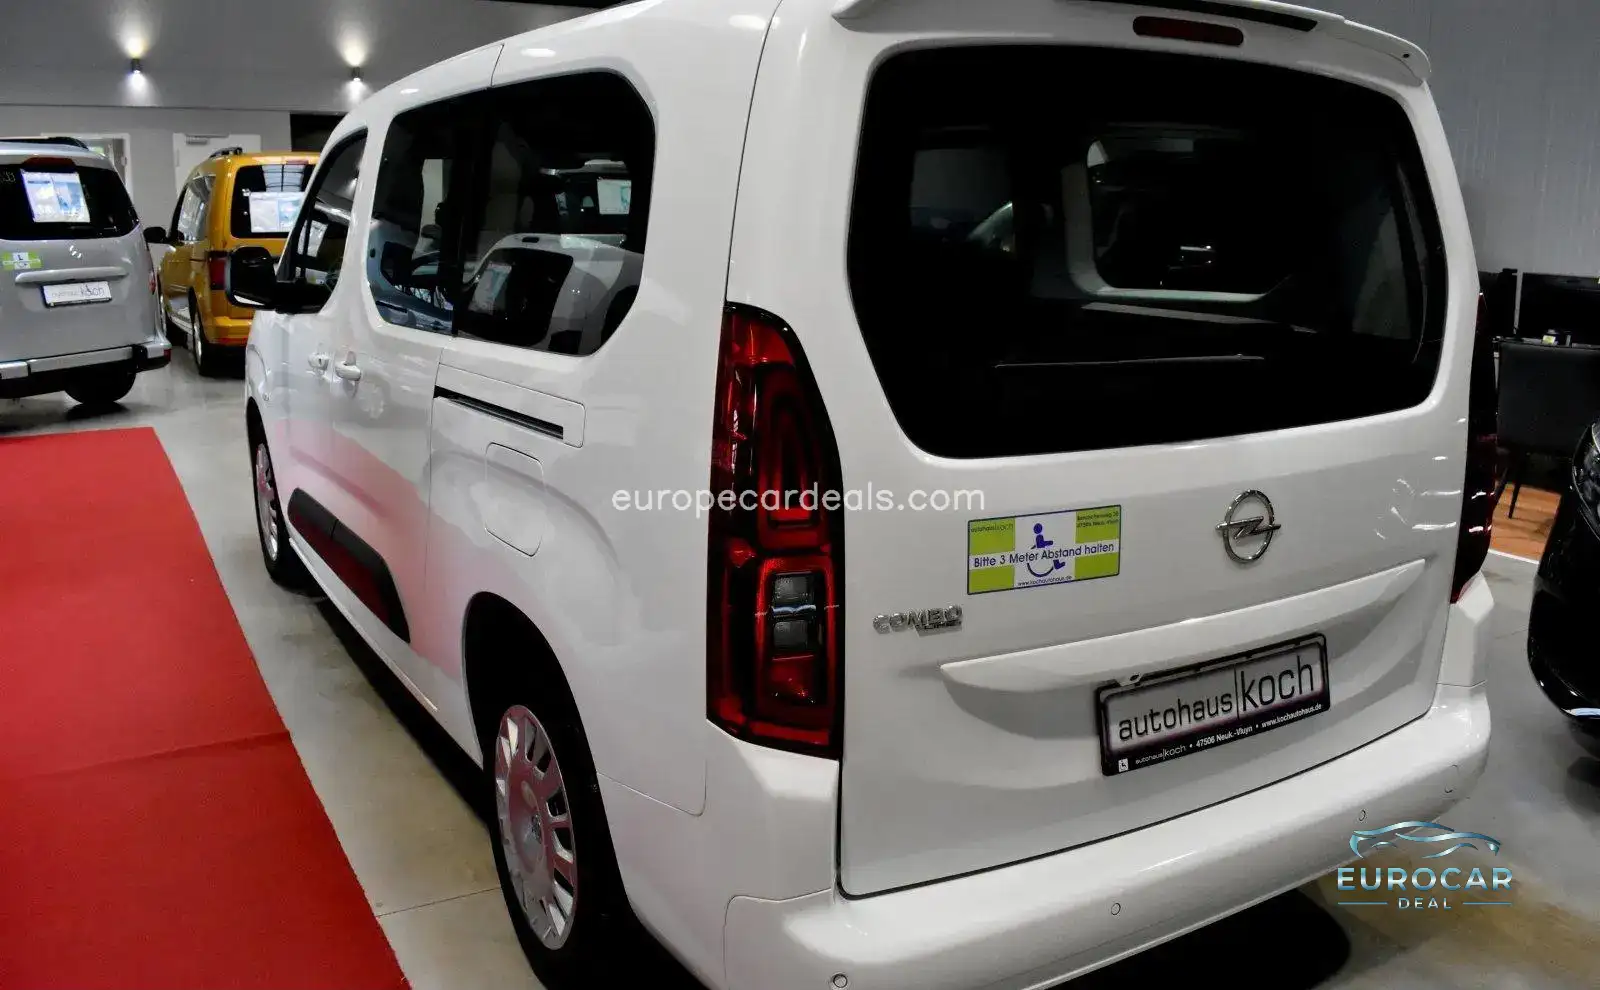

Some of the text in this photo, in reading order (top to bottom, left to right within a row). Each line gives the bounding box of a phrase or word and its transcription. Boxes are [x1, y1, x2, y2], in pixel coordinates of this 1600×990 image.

[974, 542, 1114, 568] Bitte 3 Meter Abstand halten
[872, 604, 963, 634] COMBO
[1118, 654, 1315, 742] autohaus koch
[1261, 703, 1322, 729] www.kochautohaus.de
